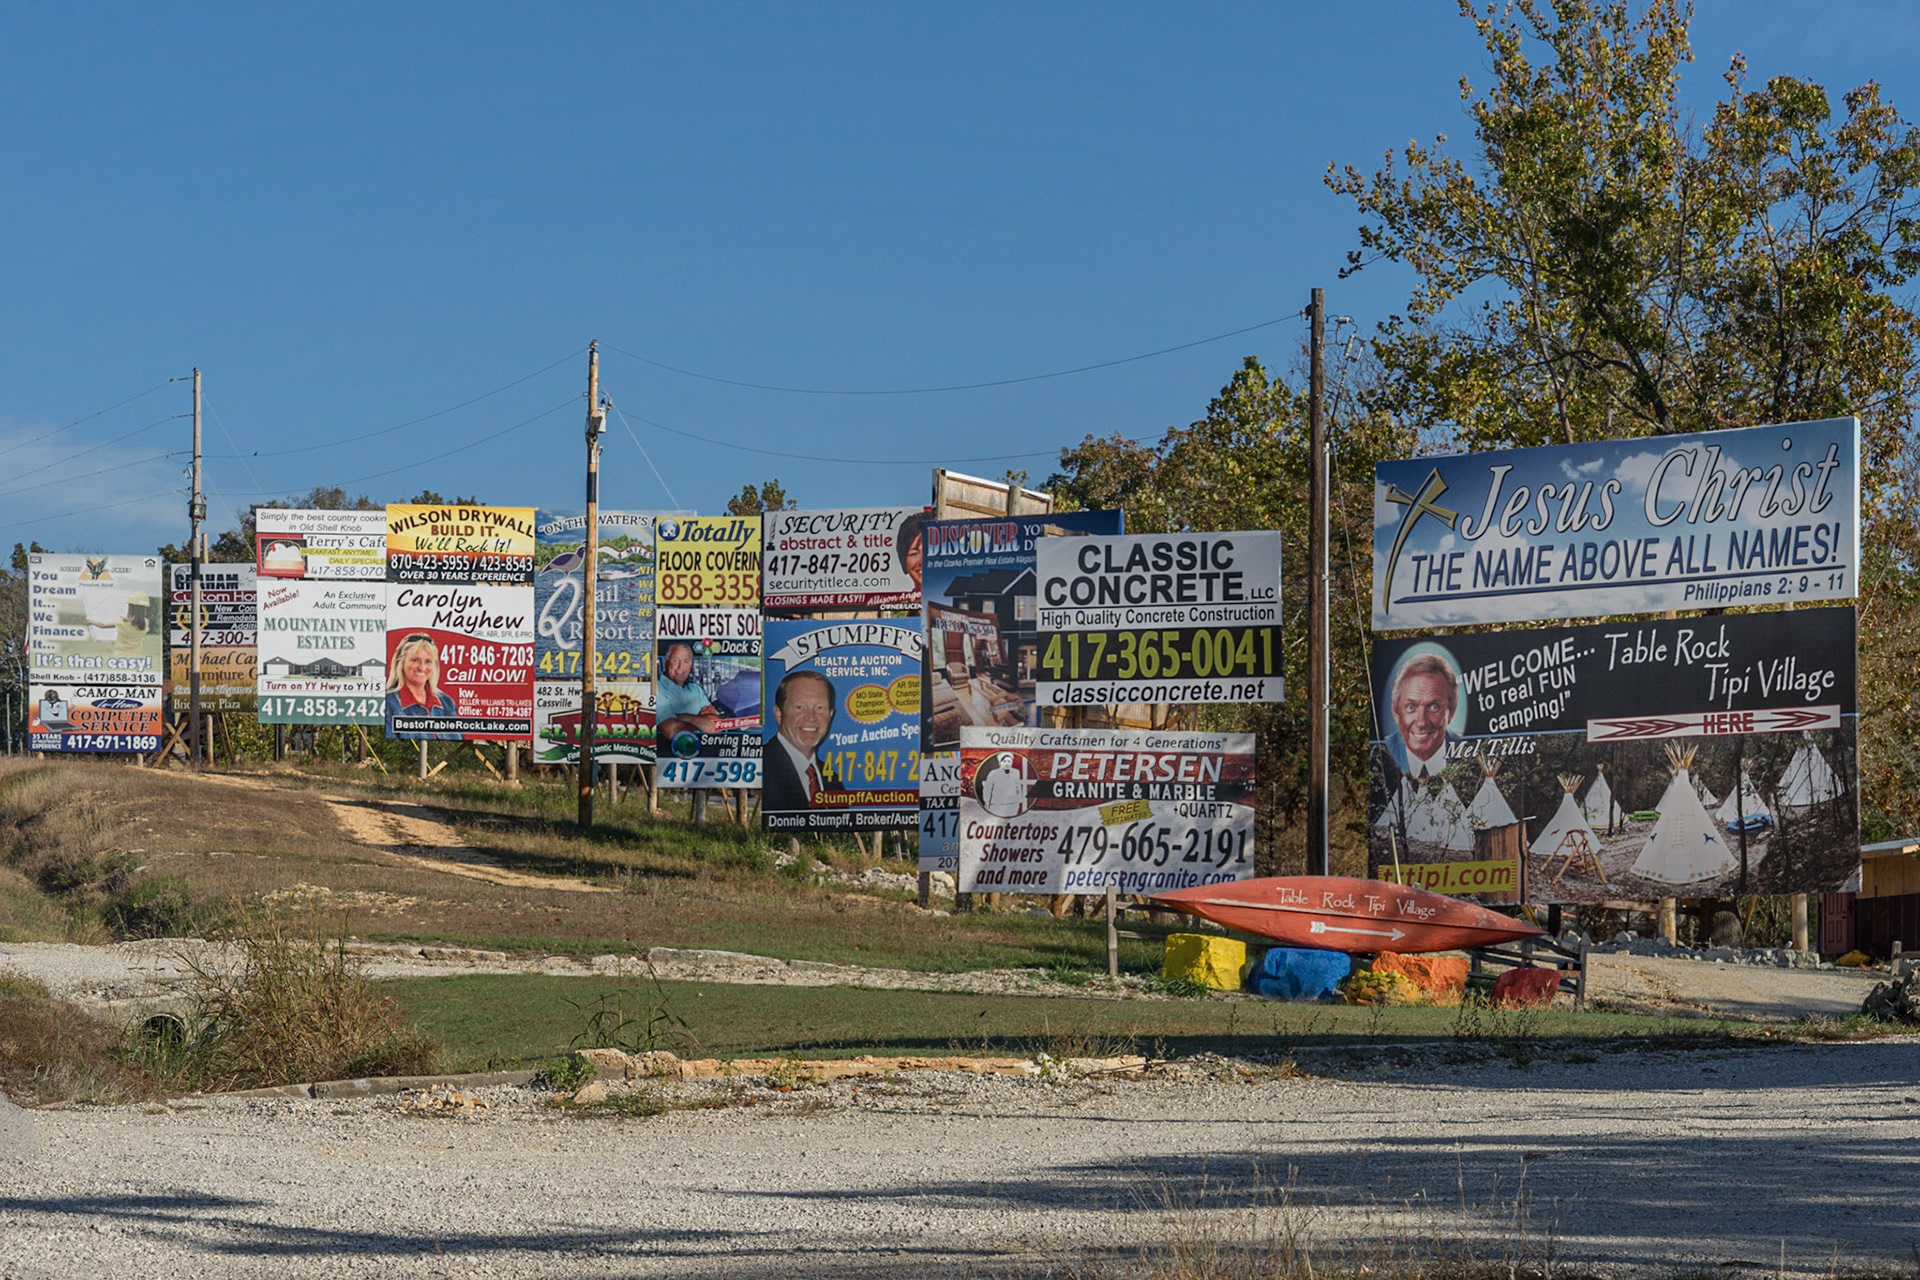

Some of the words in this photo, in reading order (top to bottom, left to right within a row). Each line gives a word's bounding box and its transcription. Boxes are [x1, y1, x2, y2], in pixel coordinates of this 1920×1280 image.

[1460, 463, 1621, 541] Jesus
[1645, 436, 1841, 527] Christ
[260, 512, 288, 523] Simply
[307, 513, 325, 521] best
[327, 515, 358, 523] country
[389, 509, 452, 534] WILSON
[458, 509, 534, 538] DRYWALL
[779, 511, 902, 536] SECURITY
[300, 523, 314, 531] Old
[341, 524, 362, 532] Knob
[431, 525, 474, 537] BUILD
[480, 525, 499, 537] IT.
[680, 520, 756, 551] Totally
[307, 535, 355, 550] Terry's
[415, 536, 452, 551] We'll
[455, 537, 488, 553] Rock
[494, 538, 512, 553] It!
[779, 536, 842, 551] abstract
[863, 533, 893, 548] title
[927, 522, 1020, 557] DISCOVER
[391, 553, 469, 571] 870-423-5955
[480, 556, 533, 572] 423-8543
[659, 551, 702, 571] FLOOR
[768, 552, 891, 576] 417-847-2063
[1077, 539, 1234, 574] CLASSIC
[1412, 550, 1462, 593] THE
[1473, 543, 1554, 589] NAME
[1559, 536, 1660, 581] ABOVE
[1665, 531, 1718, 576] ALL
[1727, 521, 1841, 571] NAMES!
[33, 571, 58, 580] You
[400, 571, 424, 580] OVER
[426, 571, 439, 580] 30
[441, 572, 469, 581] YEARS
[471, 572, 526, 582] EXPERIENCE
[769, 576, 891, 591] securitytitleca.com
[33, 585, 76, 595] Dream
[267, 586, 288, 598] Now
[338, 591, 376, 599] Exclusive
[1251, 587, 1274, 600] LLC
[1683, 580, 1772, 603] Philippians
[1777, 577, 1793, 597] 2:
[1799, 575, 1808, 593] 9
[1828, 572, 1844, 592] 11
[214, 604, 234, 612] New
[263, 590, 300, 610] Available!
[338, 602, 387, 612] Community
[397, 588, 483, 614] Carolyn
[764, 595, 808, 606] CLOSINGS
[810, 594, 835, 605] MADE
[837, 593, 866, 604] EASY!!
[33, 613, 53, 621] We
[263, 617, 346, 632] MOUNTAIN
[347, 618, 387, 633] VIEW
[432, 610, 524, 634] Mayhew
[659, 613, 695, 636] AQUA
[700, 613, 732, 636] PEST
[1041, 610, 1072, 629] High
[1075, 609, 1121, 628] Quality
[1126, 607, 1185, 624] Concrete
[1189, 605, 1275, 622] Construction
[33, 626, 84, 636] Finance
[296, 636, 355, 650] ESTATES
[721, 641, 749, 654] Dock
[796, 625, 922, 656] STUMPFF'S
[1603, 632, 1668, 671] Table
[1673, 624, 1731, 666] Rock
[814, 656, 849, 666] REALTY
[860, 655, 902, 665] AUCTION
[1042, 627, 1273, 680] 417-365-0041
[35, 653, 62, 667] It's
[67, 654, 103, 669] that
[107, 655, 153, 673] easy!
[825, 667, 869, 677] SERVICE,
[871, 666, 891, 676] INC.
[84, 673, 156, 684] (417)858-3136
[447, 668, 477, 682] Call
[481, 668, 526, 683] NOW!
[1704, 662, 1751, 709] Tipi
[1757, 656, 1836, 701] Village
[77, 687, 157, 698] CAMO-MAN
[265, 681, 287, 690] Turn
[290, 682, 302, 690] on
[305, 682, 317, 690] YY
[320, 682, 342, 693] Hwy
[343, 683, 354, 691] to
[536, 687, 552, 696] 482
[554, 687, 565, 696] St.
[1052, 679, 1265, 704] classicconcrete.net
[1478, 693, 1495, 712] to
[1501, 684, 1534, 707] real
[1538, 665, 1576, 692] FUN
[219, 698, 241, 709] Plaza
[536, 698, 573, 707] Cassville
[70, 710, 158, 722] COMPUTER
[1488, 691, 1571, 734] camping!"
[80, 721, 149, 732] SERVICE
[395, 719, 529, 731] BestofTableRockLake.com
[1703, 712, 1754, 734] HERE
[67, 735, 157, 750] 417-671-1869
[700, 734, 739, 748] Serving
[860, 726, 899, 743] Auction
[1040, 733, 1105, 747] Craftsmen
[1110, 735, 1129, 748] for
[1132, 736, 1141, 747] 4
[1145, 737, 1228, 750] Generations"
[613, 744, 639, 754] Mexican
[719, 747, 738, 757] and
[1445, 739, 1479, 759] Mel
[1486, 736, 1536, 757] Tillis
[1049, 752, 1225, 783] PETERSEN
[1053, 781, 1126, 799] GRANITE
[1149, 783, 1216, 801] MARBLE
[925, 798, 946, 809] TAX
[1111, 801, 1141, 815] FREE
[1173, 802, 1234, 819] +QUARTZ
[768, 812, 806, 827] Donnie
[808, 811, 853, 828] Stumpff,
[1104, 810, 1149, 825] ESTIMATES
[966, 821, 1059, 844] Countertops
[980, 843, 1044, 863] Showers
[1057, 821, 1247, 868] 479-665-2191
[976, 865, 1016, 885] and
[1021, 869, 1048, 885] more
[1064, 867, 1236, 890] petersengranite.com
[1276, 887, 1308, 906] Table
[1322, 891, 1355, 910] Rock
[1365, 894, 1386, 914] Tipi
[1396, 898, 1437, 920] Village
